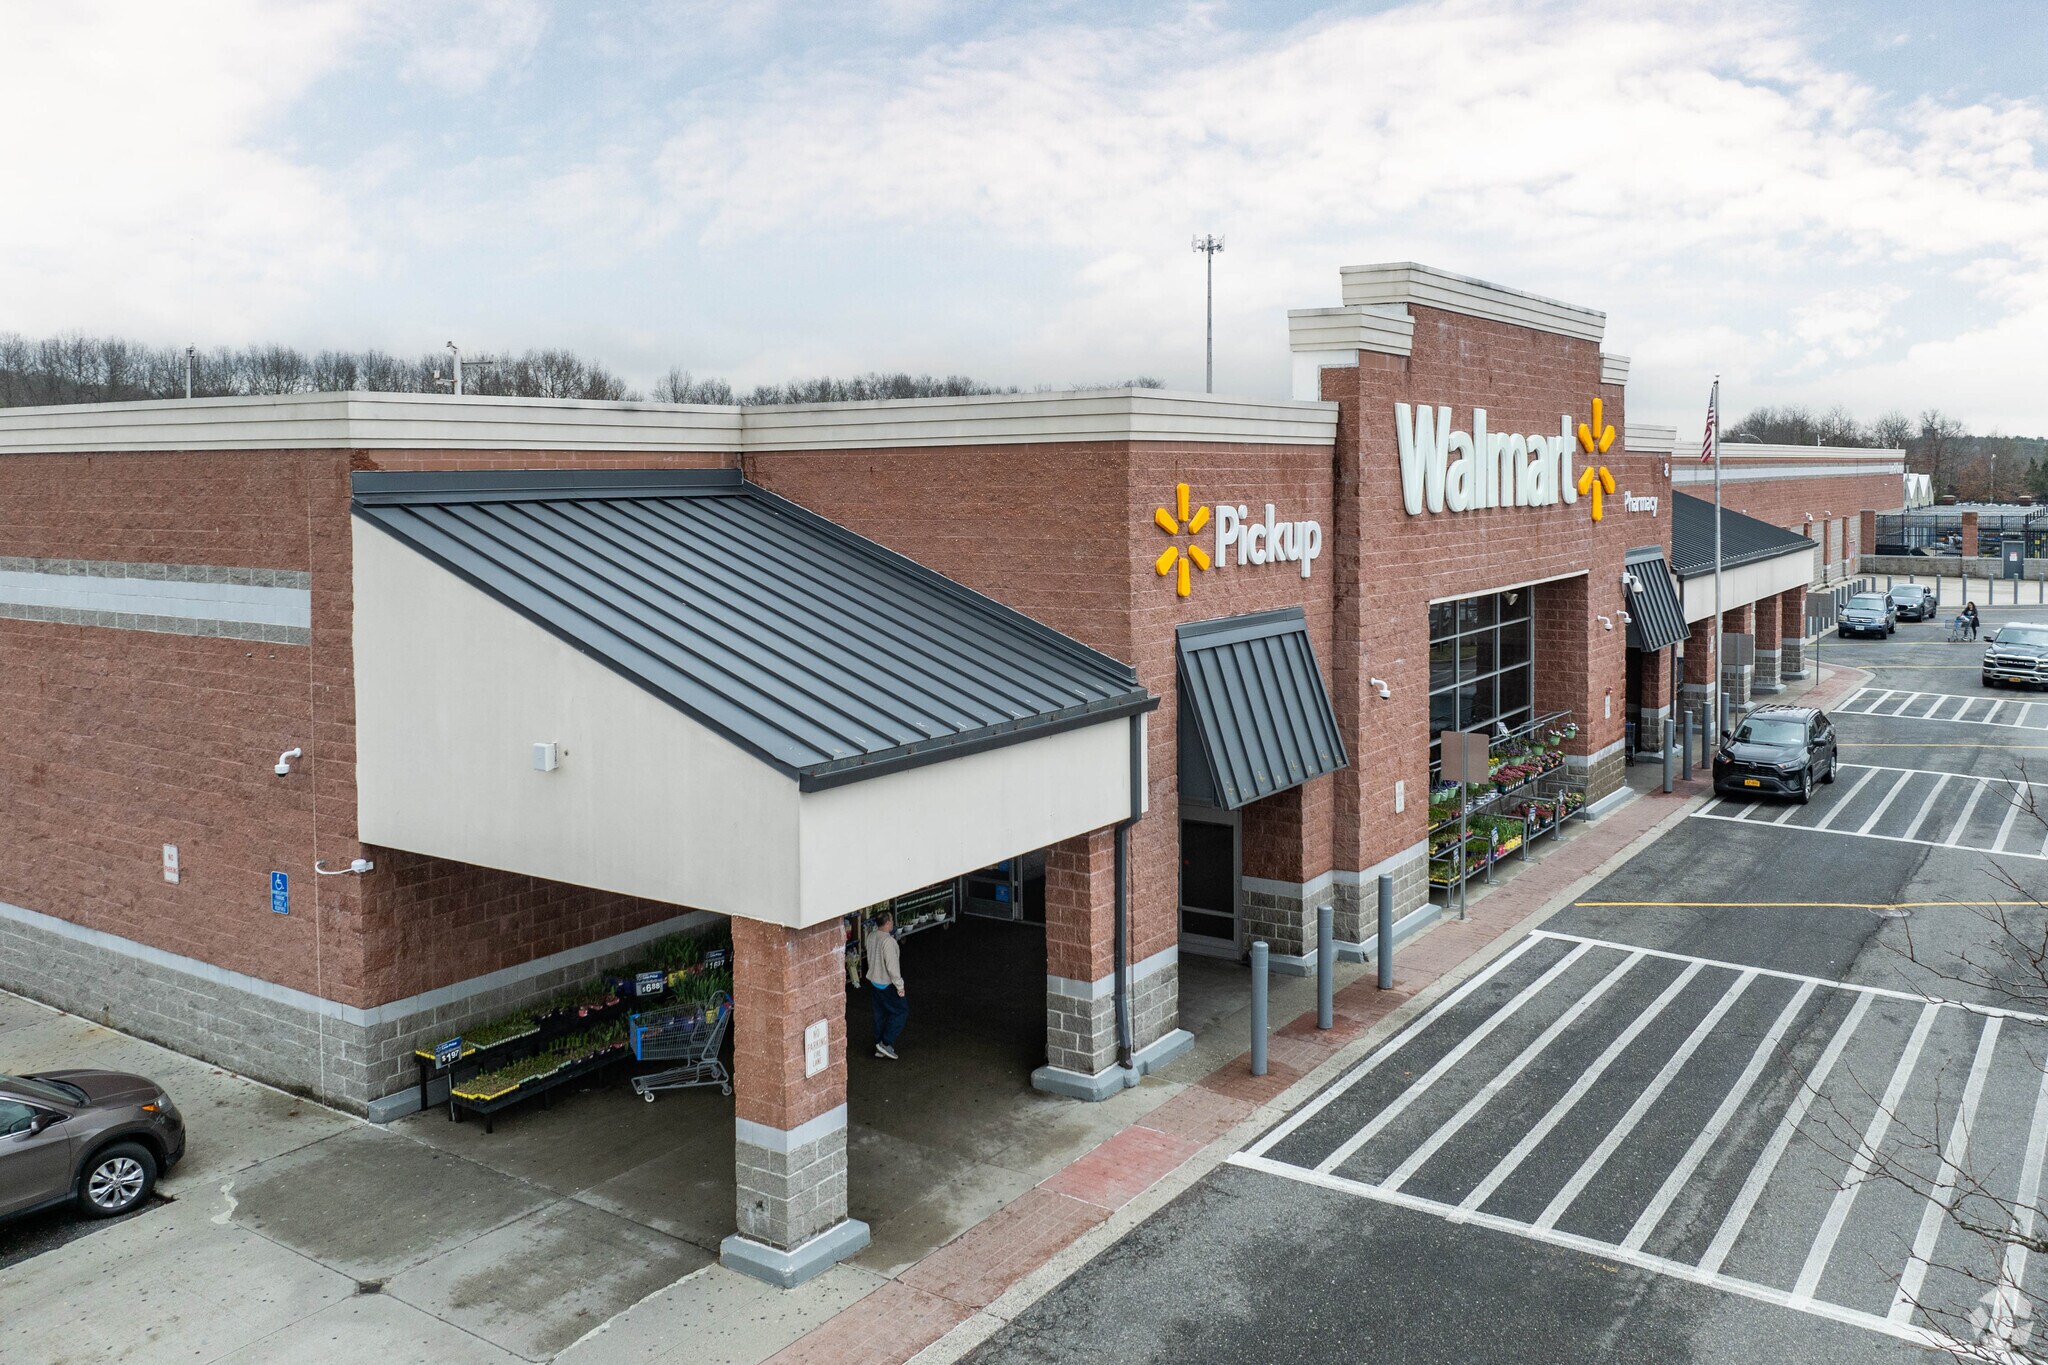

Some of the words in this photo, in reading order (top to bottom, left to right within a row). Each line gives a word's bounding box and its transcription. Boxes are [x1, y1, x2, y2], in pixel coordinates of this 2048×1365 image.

[1394, 402, 1577, 516] Walmart
[1624, 490, 1659, 517] Pharmacy
[1215, 503, 1322, 579] Pickup
[813, 1028, 820, 1039] NO
